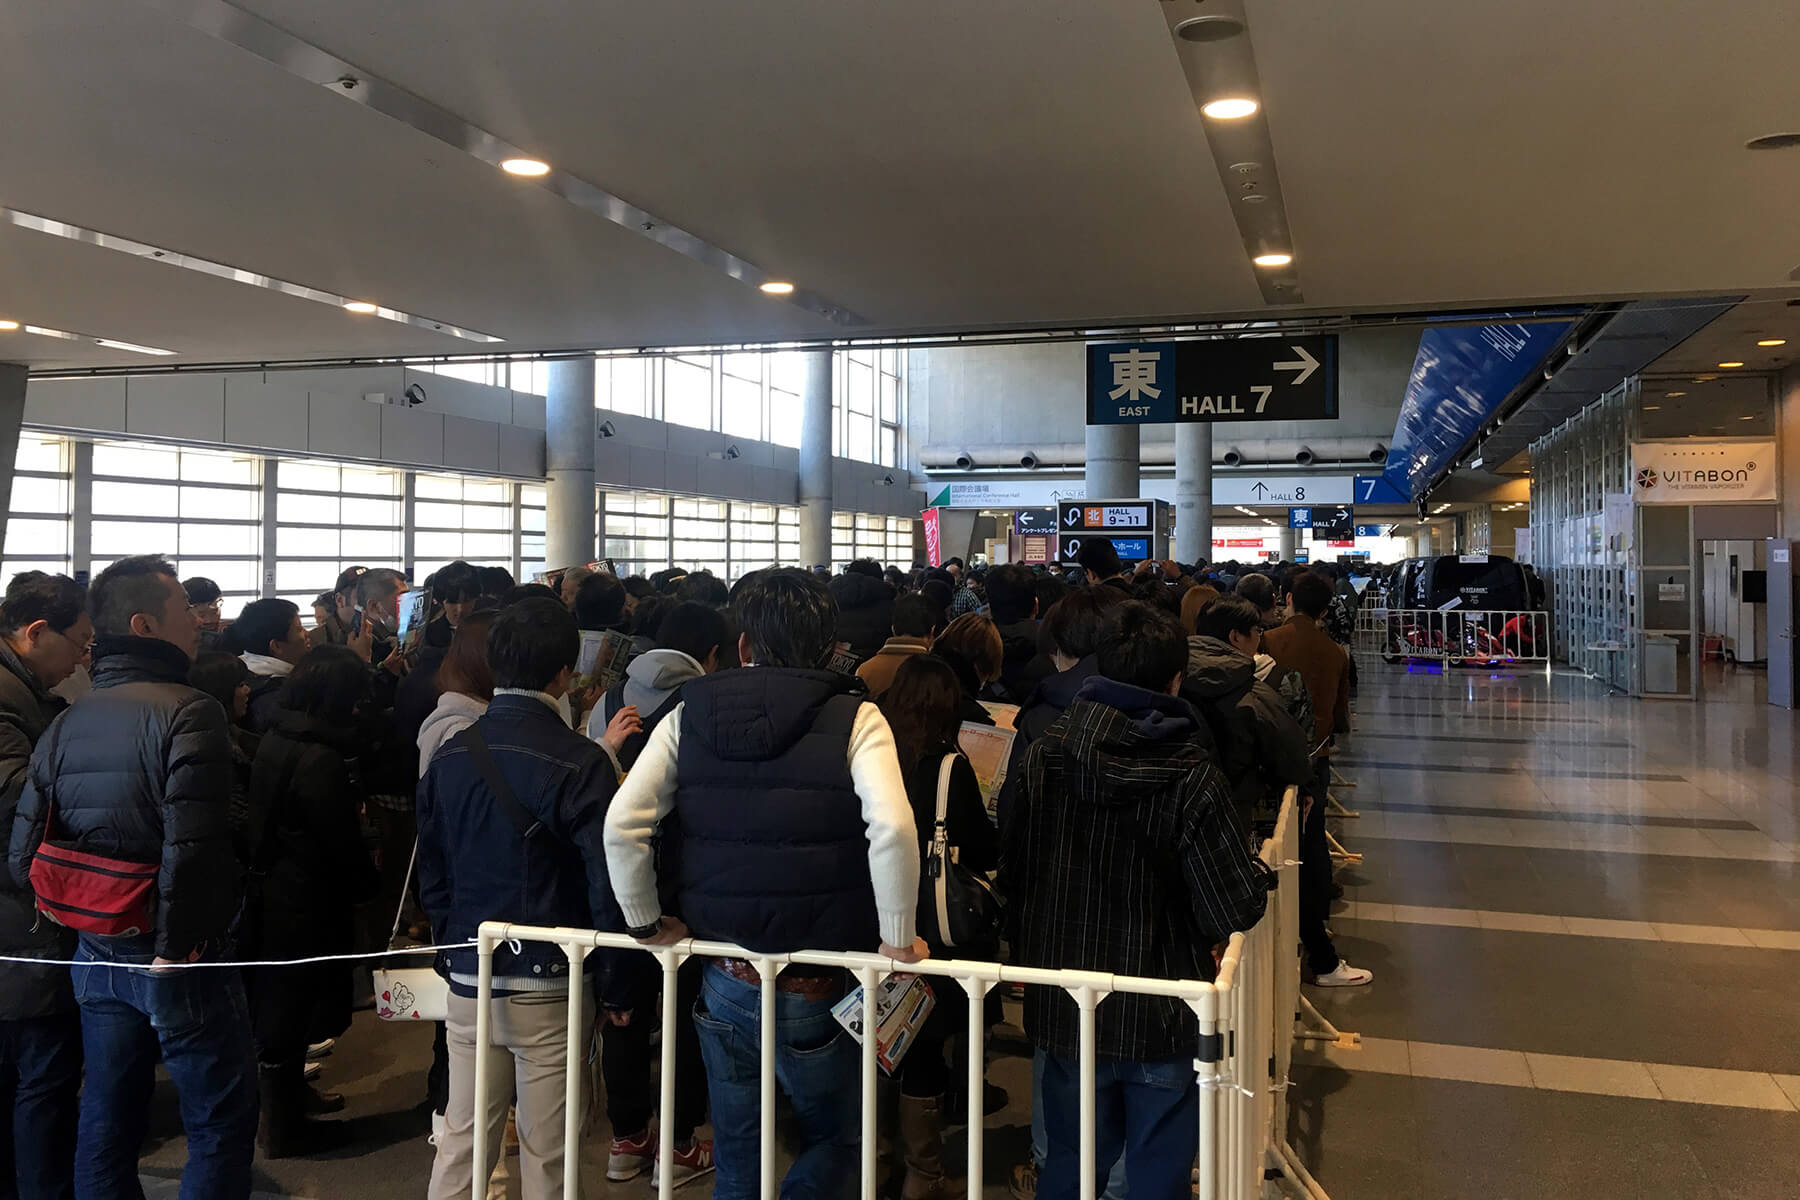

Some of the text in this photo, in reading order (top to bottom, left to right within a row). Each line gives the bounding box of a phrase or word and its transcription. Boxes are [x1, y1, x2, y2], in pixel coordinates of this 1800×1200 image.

[1109, 348, 1161, 401] 東
[1182, 386, 1272, 415] HALL 7
[1119, 407, 1150, 416] EAST
[1663, 470, 1748, 482] VITABON
[1295, 487, 1305, 500] 8
[1361, 480, 1376, 500] 7
[1088, 509, 1100, 521] 北
[1293, 508, 1309, 523] 東
[1330, 519, 1337, 527] 7
[1358, 526, 1366, 536] 8
